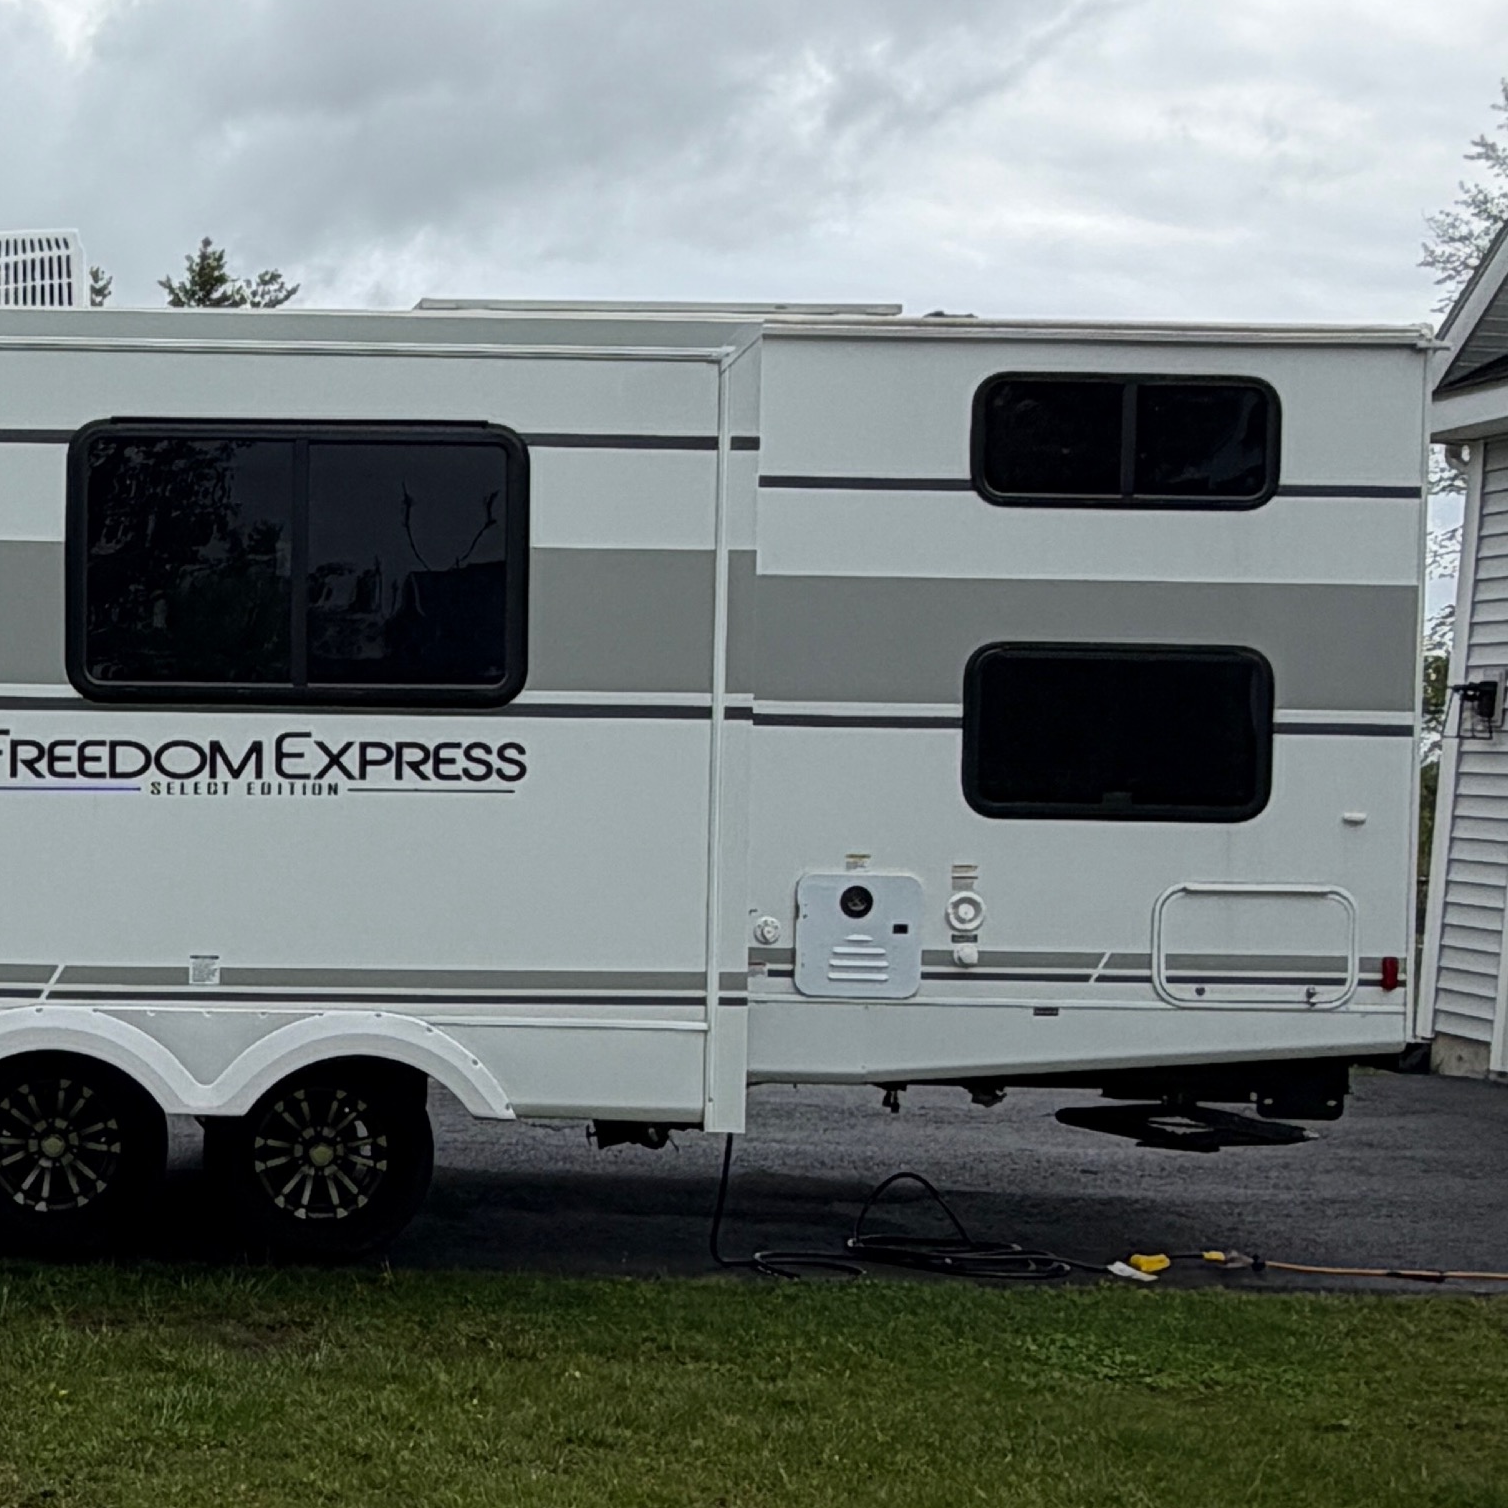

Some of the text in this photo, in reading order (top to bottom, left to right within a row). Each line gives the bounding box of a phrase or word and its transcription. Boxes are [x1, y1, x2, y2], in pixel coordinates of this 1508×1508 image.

[274, 731, 528, 783] EXPRESS
[149, 780, 340, 797] SELECT EDITION
